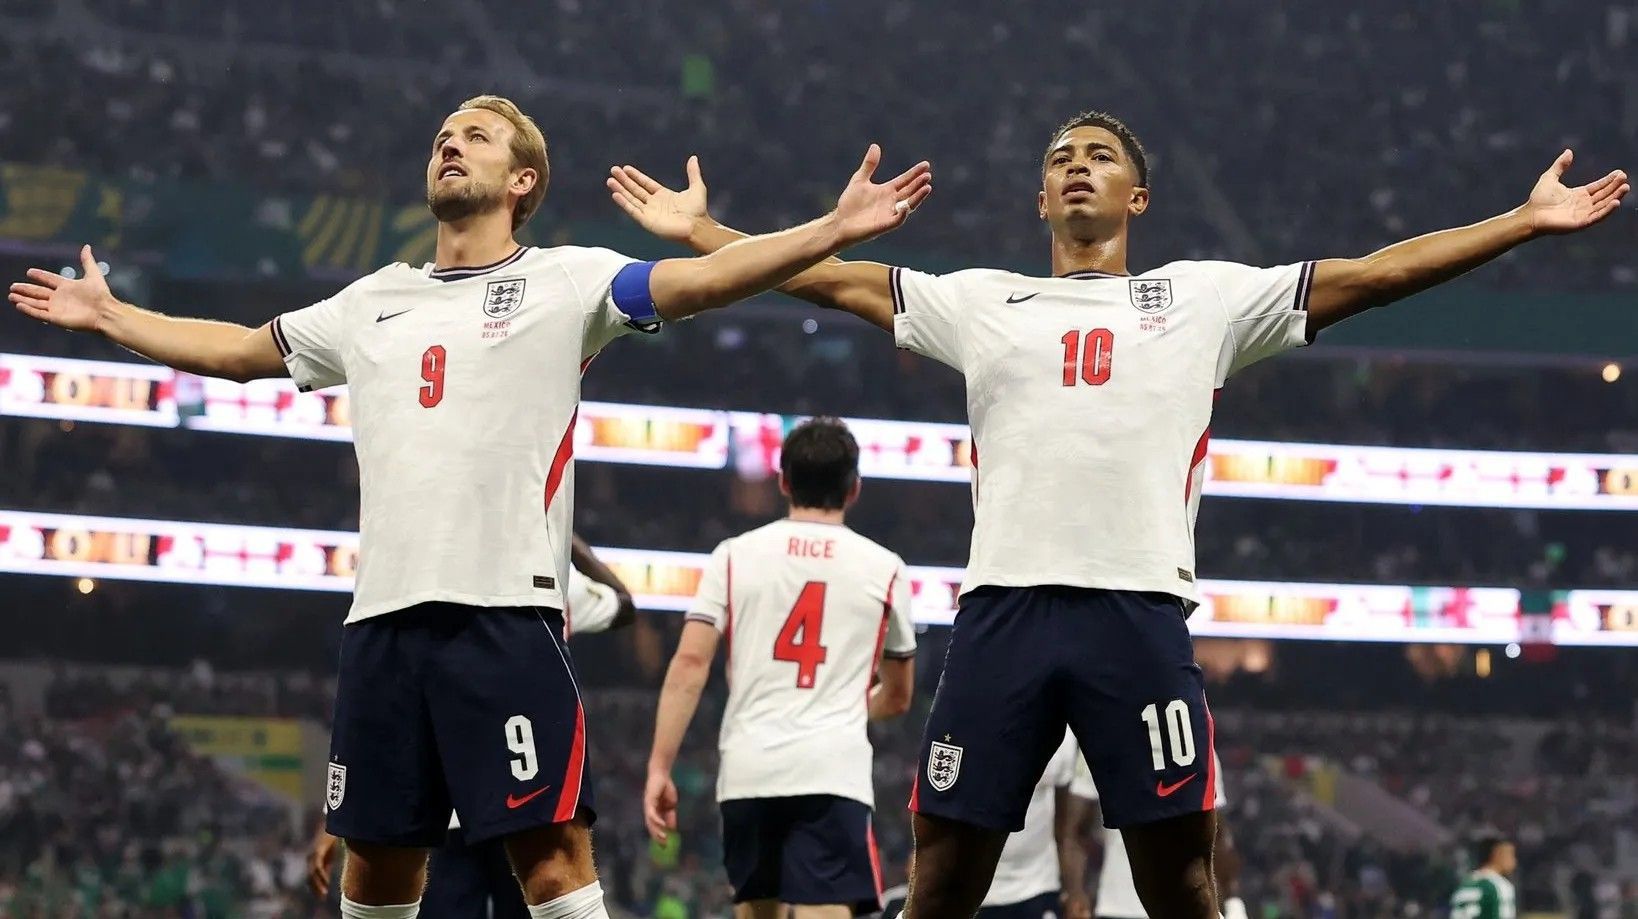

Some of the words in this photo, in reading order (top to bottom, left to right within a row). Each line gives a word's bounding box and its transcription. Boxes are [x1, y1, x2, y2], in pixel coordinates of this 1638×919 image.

[419, 345, 446, 408] 9
[1061, 328, 1114, 387] 10
[787, 537, 836, 559] RICE
[773, 581, 828, 688] 4
[504, 715, 539, 781] 9
[1141, 699, 1196, 771] 10
